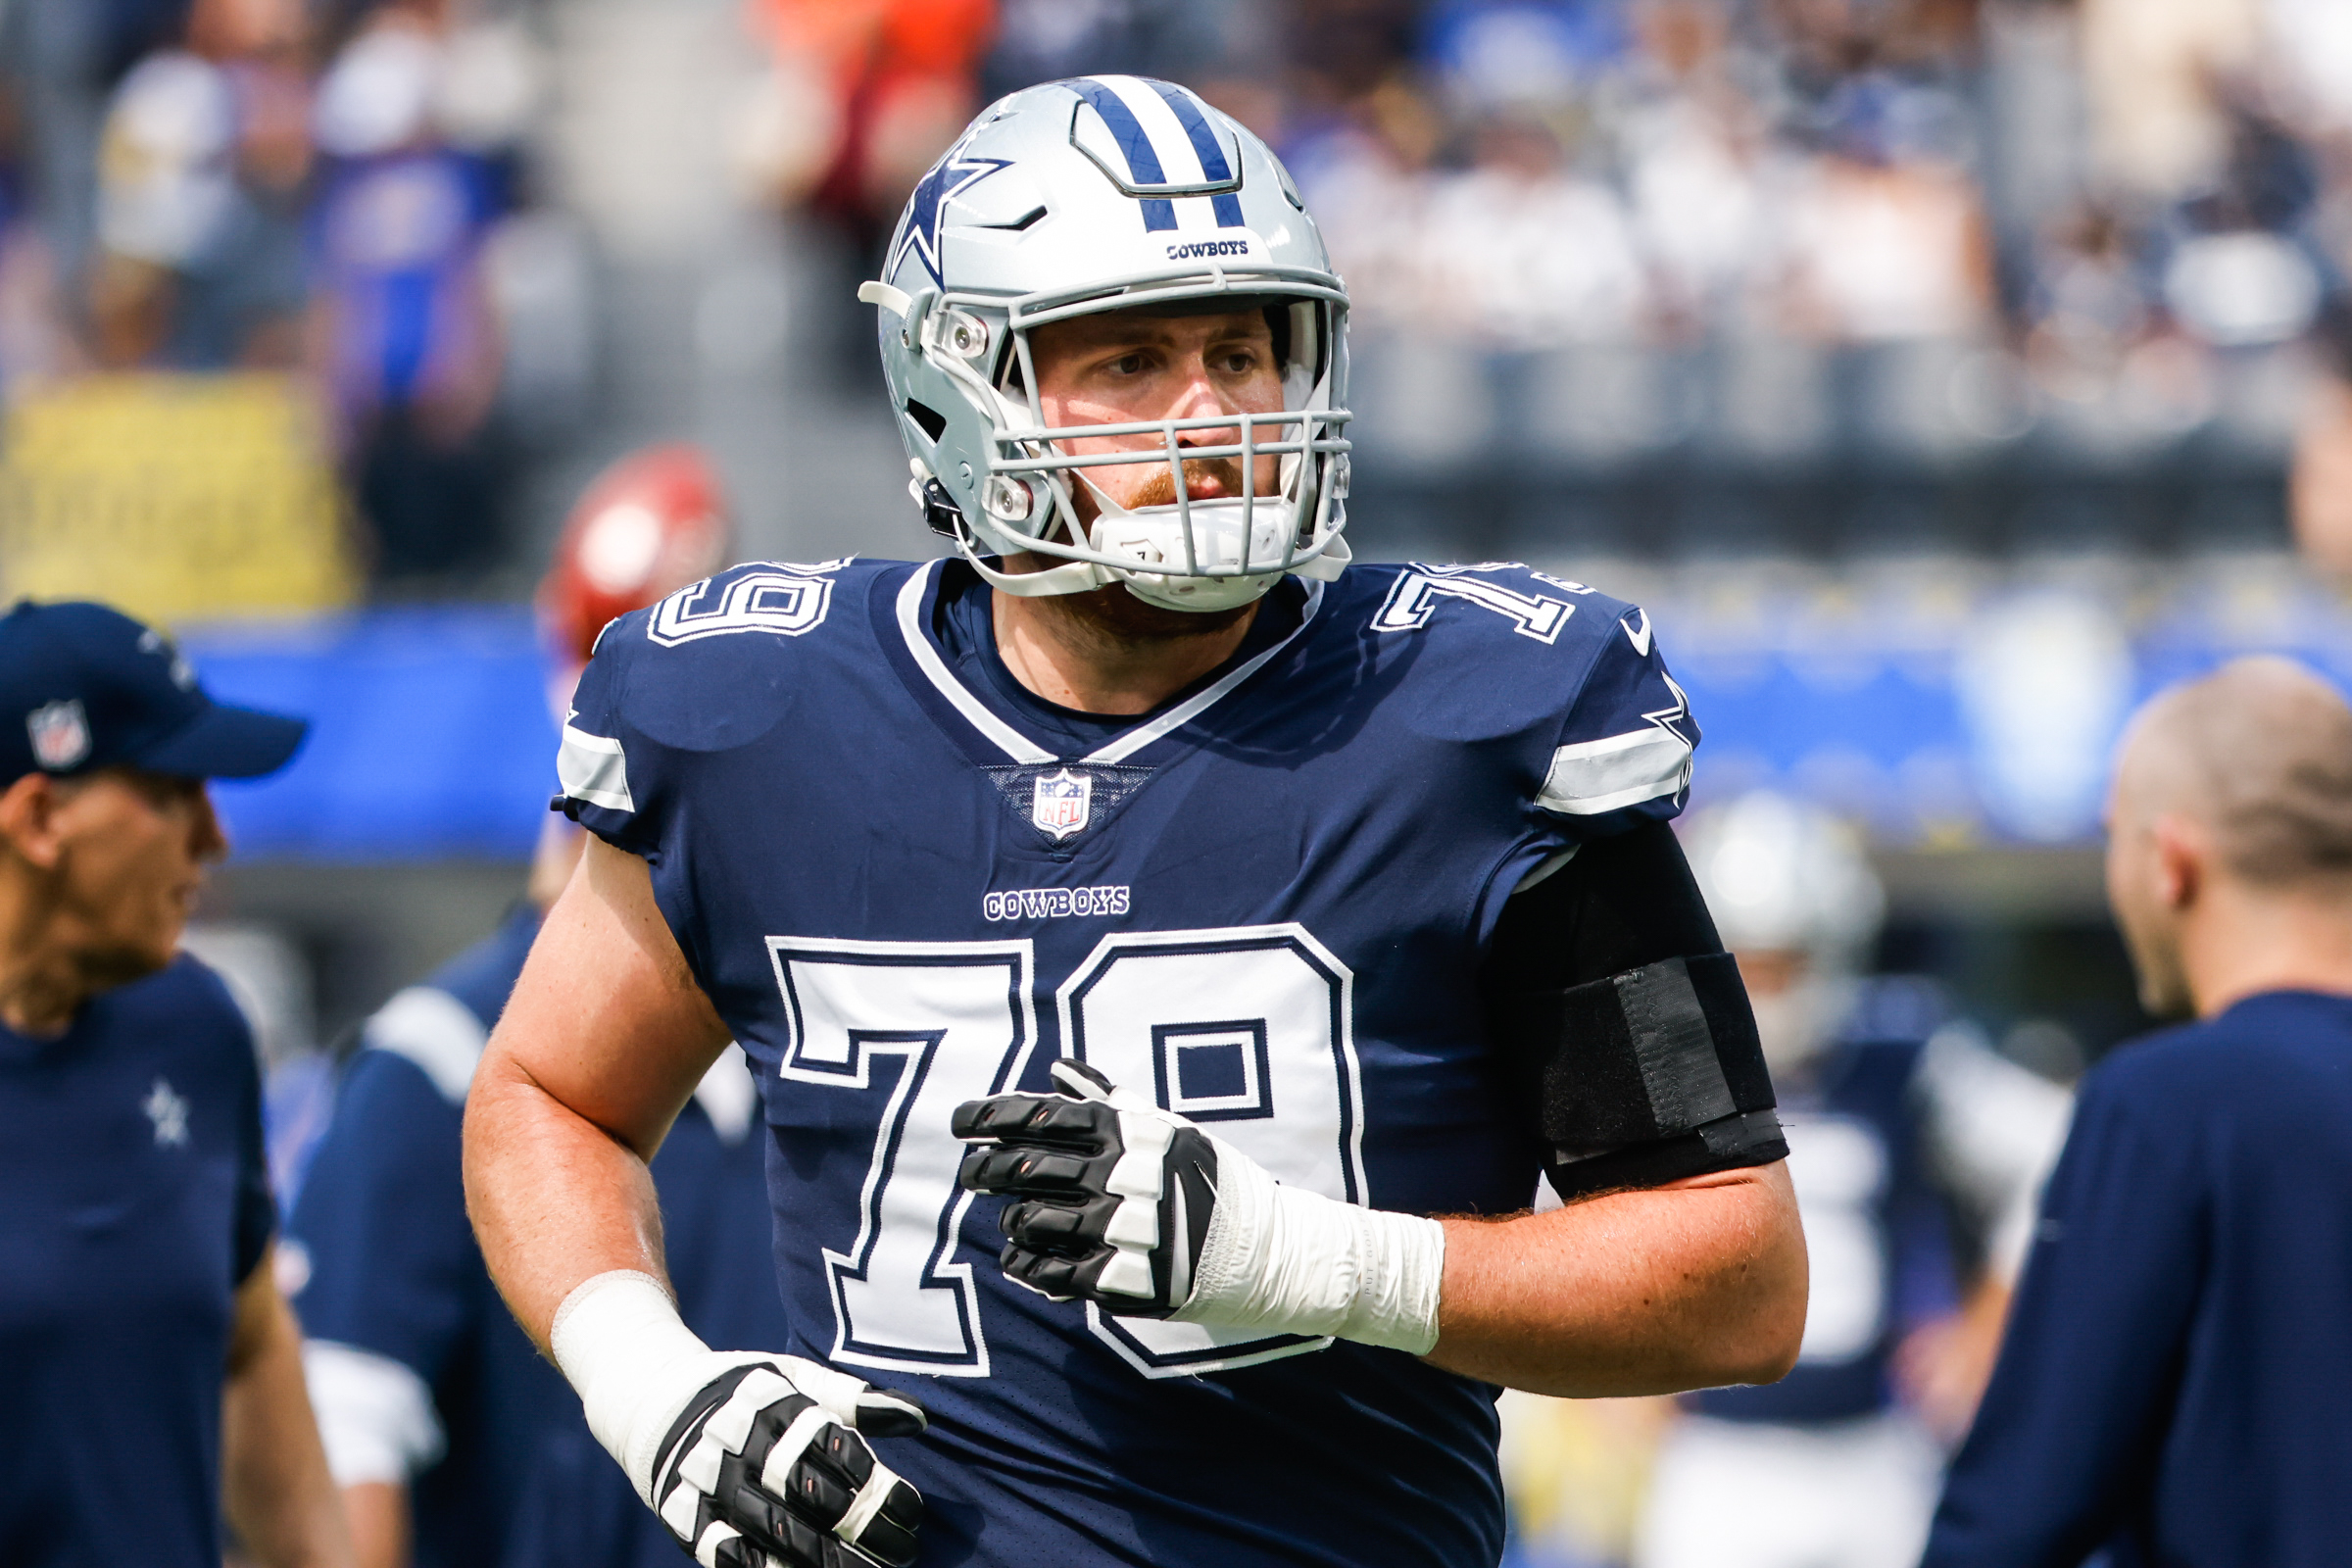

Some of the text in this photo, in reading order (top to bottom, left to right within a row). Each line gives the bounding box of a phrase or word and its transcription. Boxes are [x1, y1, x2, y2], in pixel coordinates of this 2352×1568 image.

[1166, 240, 1249, 260] COWBOYS
[1043, 800, 1080, 826] NFL
[984, 886, 1130, 921] COWBOYS
[764, 921, 1370, 1380] 79
[1364, 1268, 1374, 1297] PUT
